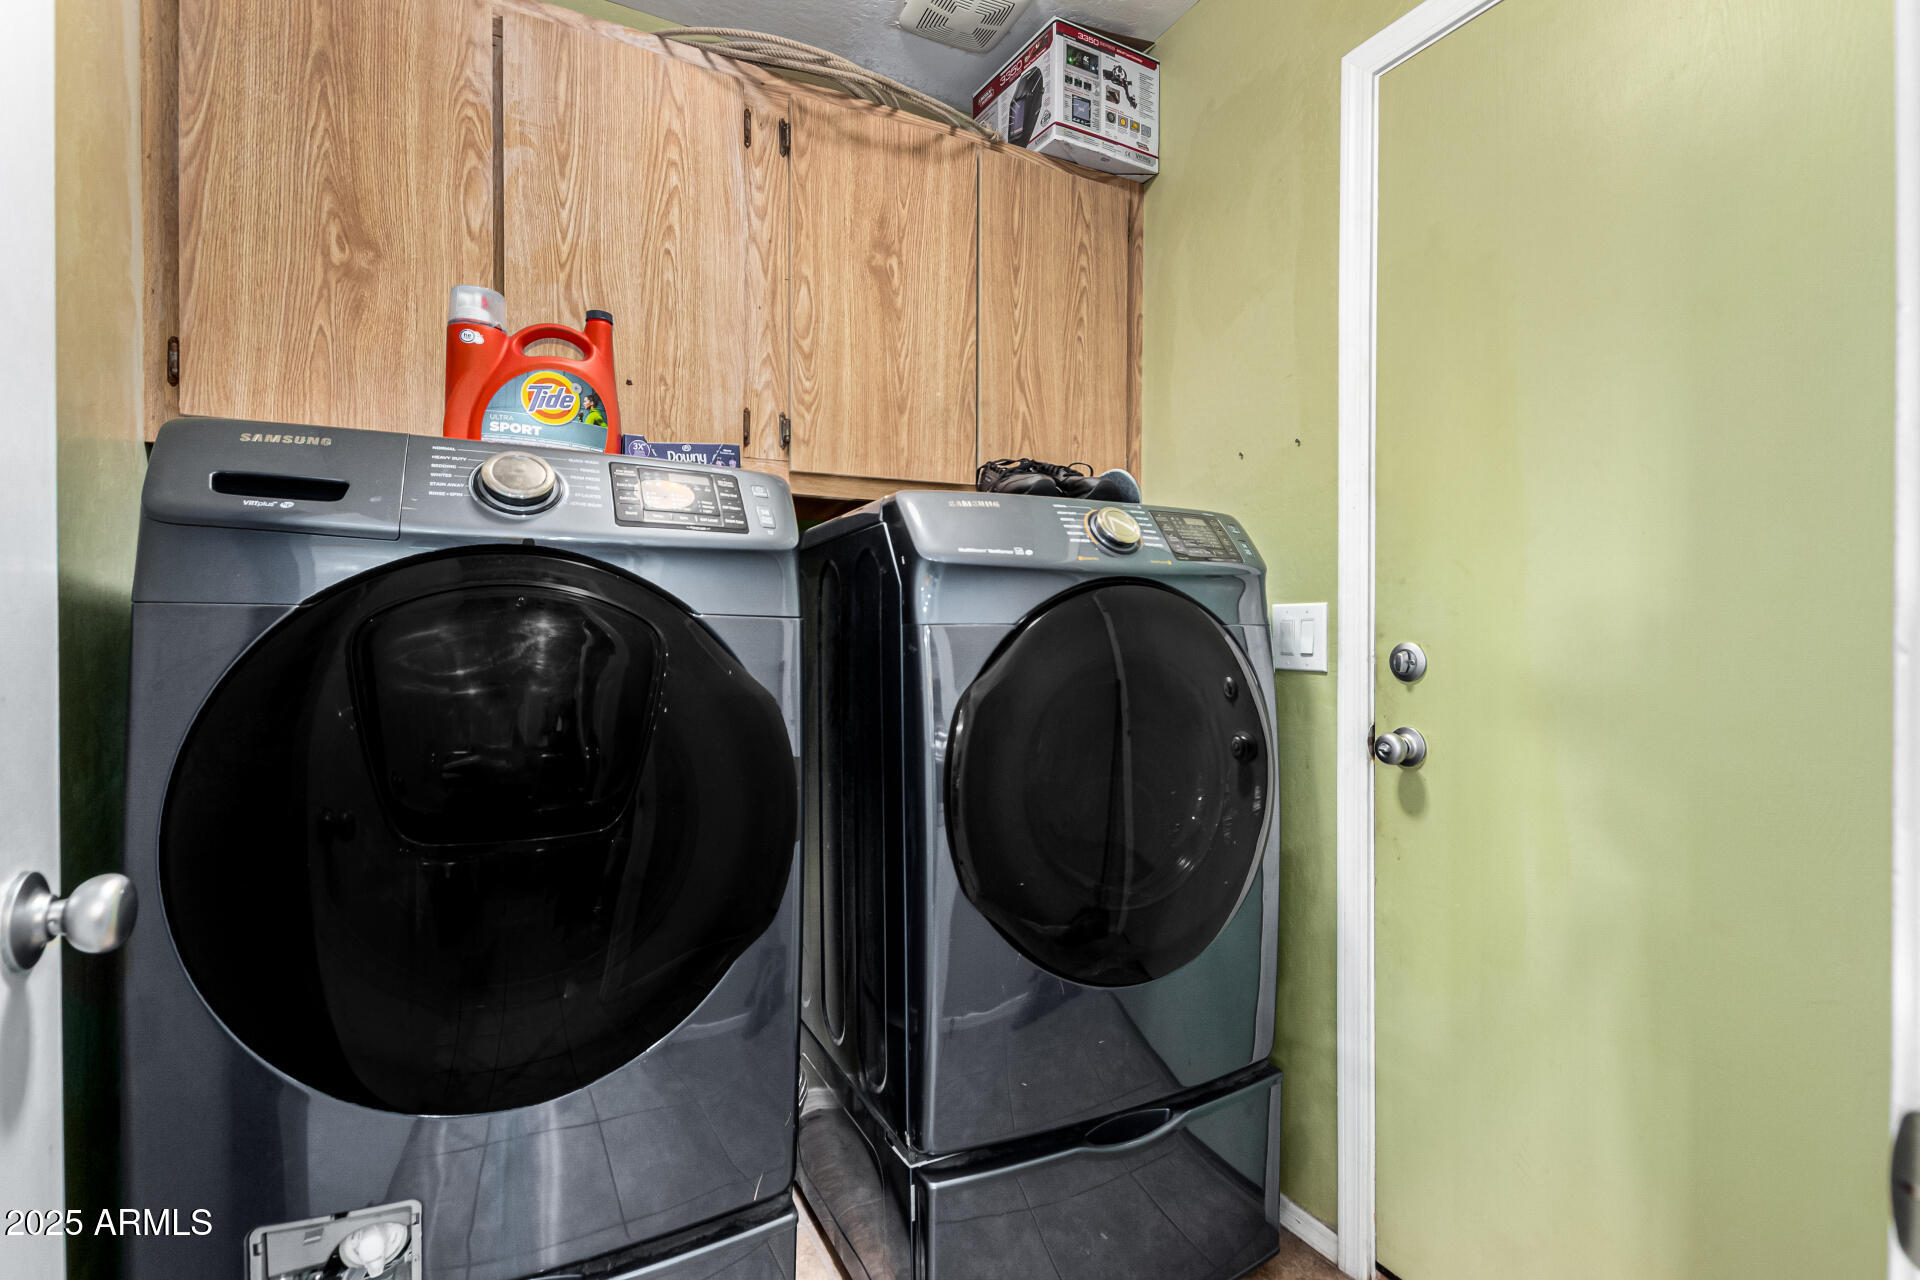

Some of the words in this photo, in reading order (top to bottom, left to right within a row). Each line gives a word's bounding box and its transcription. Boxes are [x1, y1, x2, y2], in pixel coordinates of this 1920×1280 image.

[527, 384, 575, 413] Tide
[489, 421, 543, 436] SPORT
[239, 433, 332, 446] SAMSUNG
[667, 450, 707, 465] Downy
